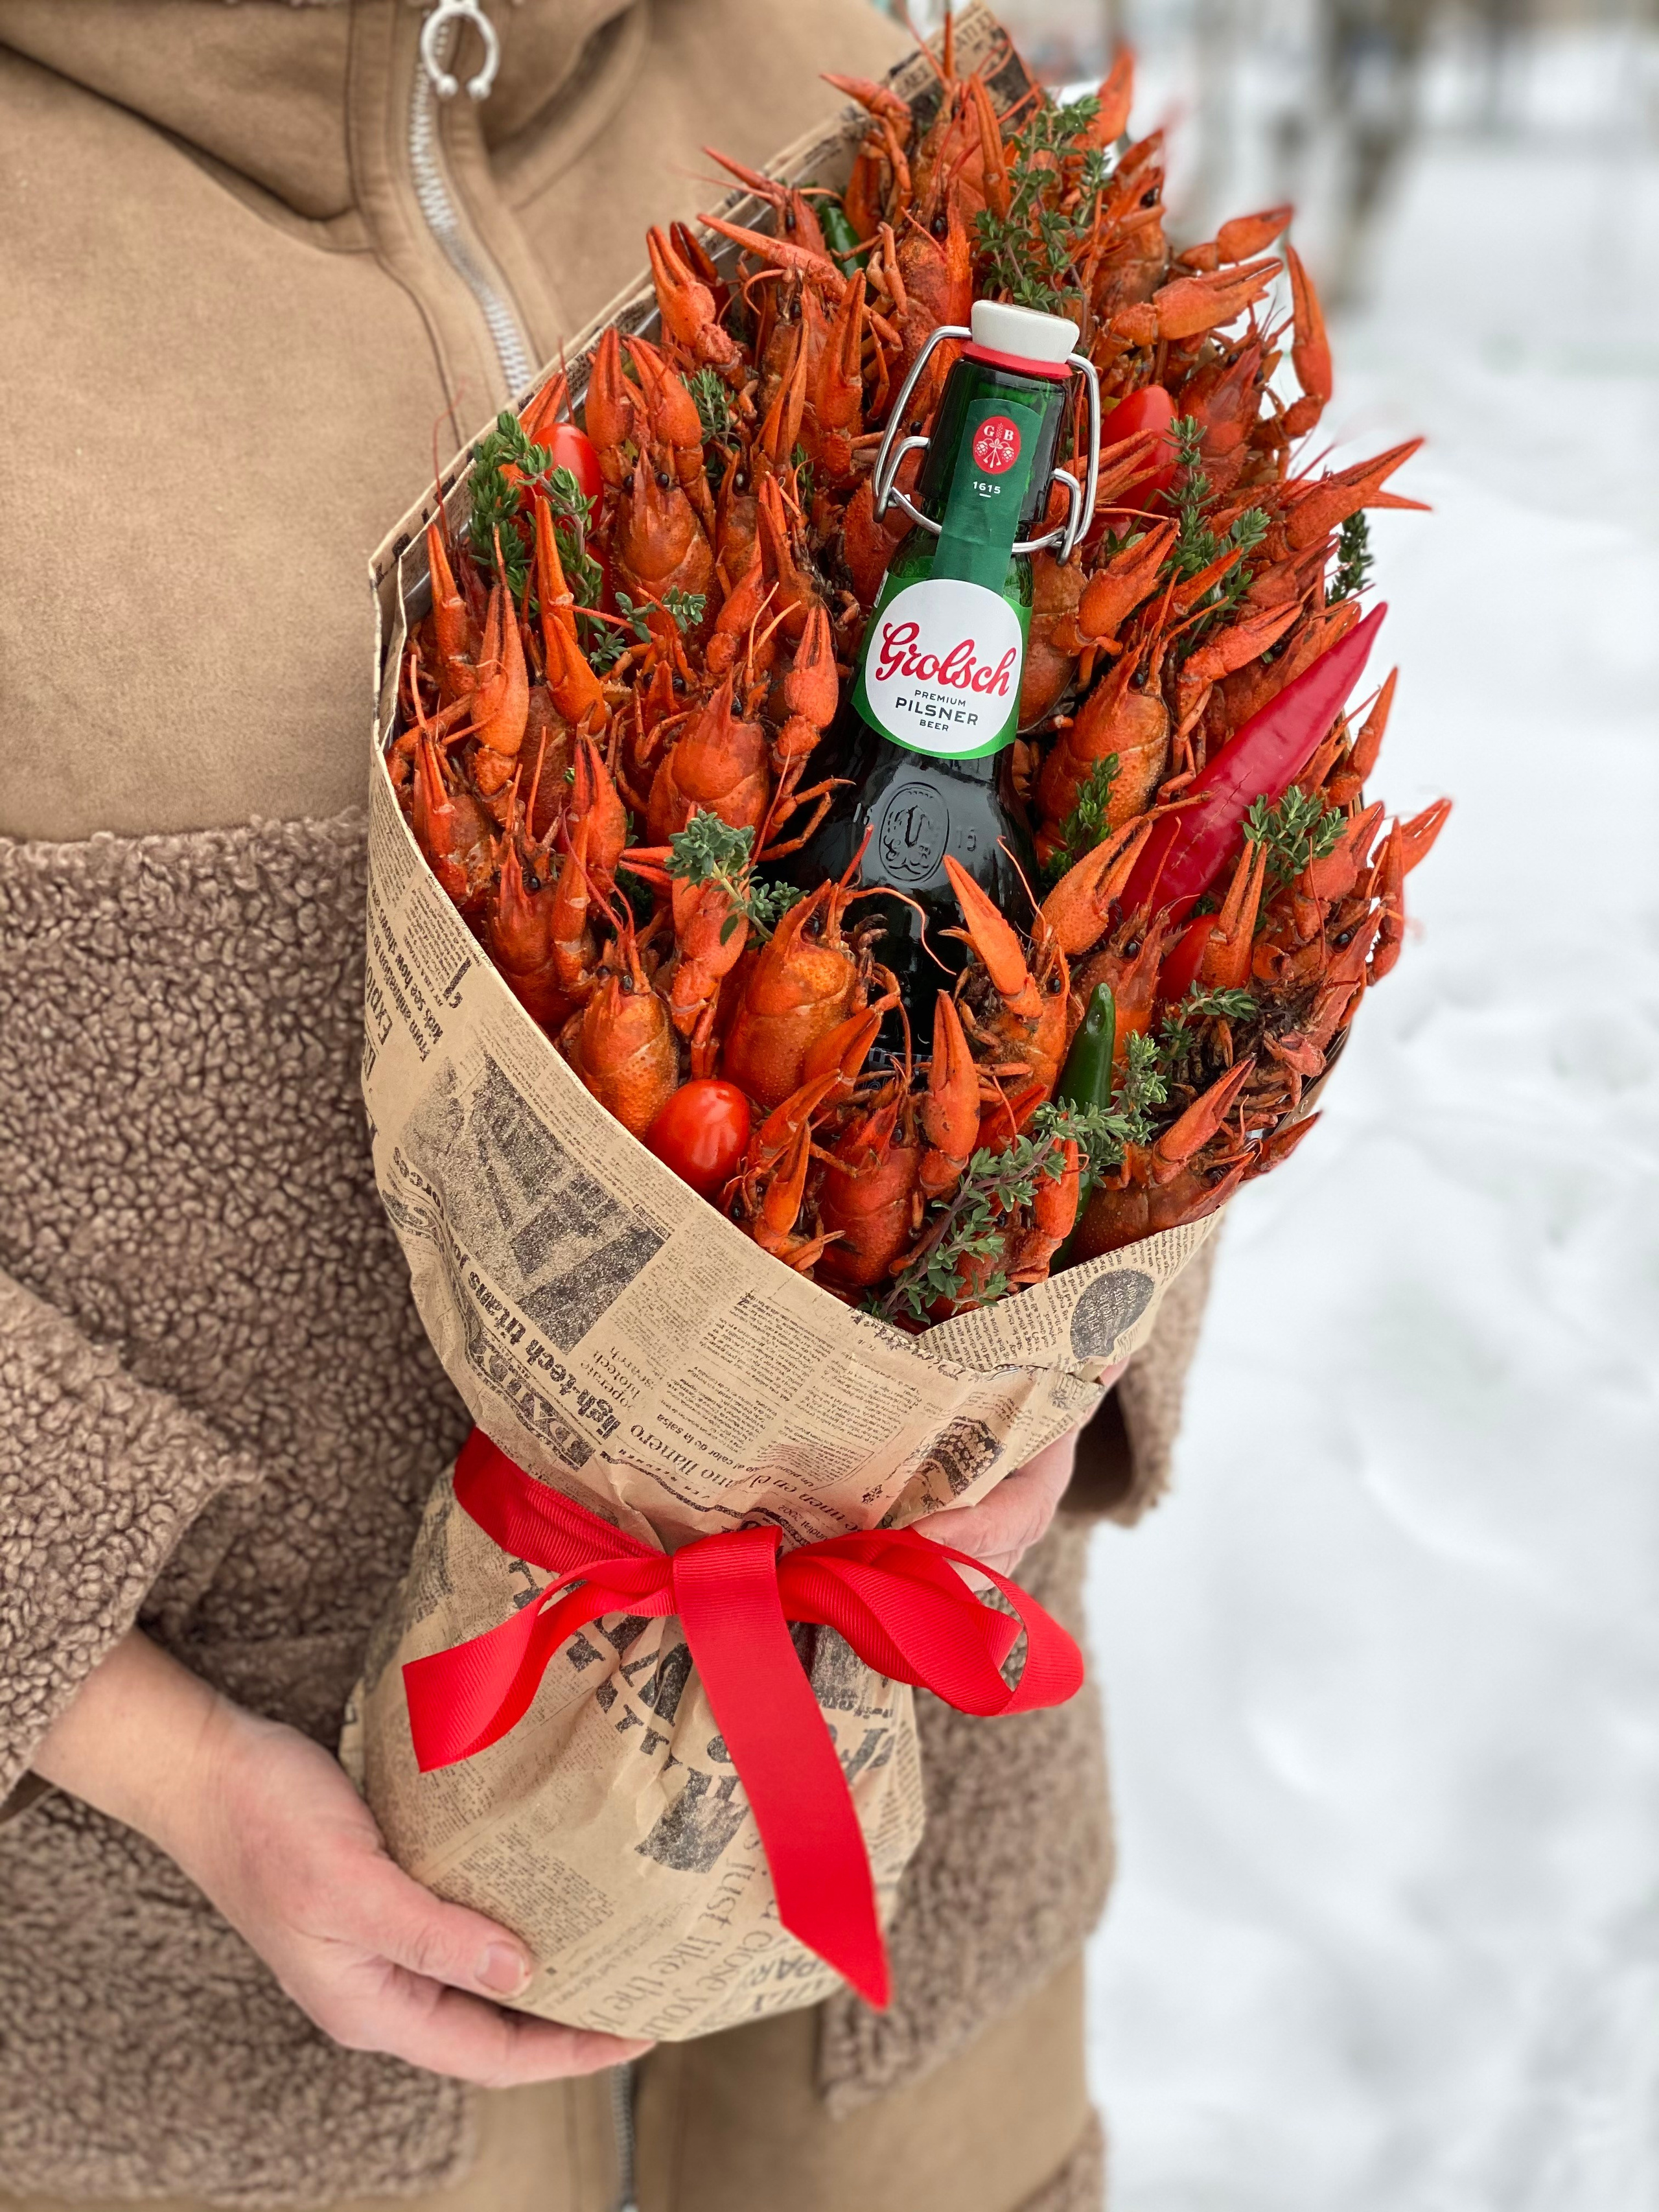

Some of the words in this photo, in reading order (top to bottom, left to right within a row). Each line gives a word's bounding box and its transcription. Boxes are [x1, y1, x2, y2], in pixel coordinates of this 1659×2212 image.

[972, 481, 1001, 494] 1615
[874, 618, 1017, 697] Grolsch
[895, 696, 979, 725] PILSNER
[914, 690, 966, 706] PREMIUM
[919, 719, 949, 732] BEER
[377, 908, 398, 955] shows
[378, 949, 413, 1023] animation
[394, 953, 413, 990] how
[410, 983, 427, 1012] see
[408, 1019, 430, 1062] From
[421, 1007, 444, 1044] kids
[467, 1272, 527, 1344] titans
[468, 1339, 577, 1450] DAILY
[655, 1412, 684, 1436] salsa
[681, 1432, 694, 1443] la
[629, 1422, 699, 1476] llanero
[692, 1439, 708, 1453] de
[707, 1447, 734, 1467] calor
[698, 1861, 757, 1929] just
[648, 1935, 722, 1975] like
[603, 1975, 664, 2012] the
